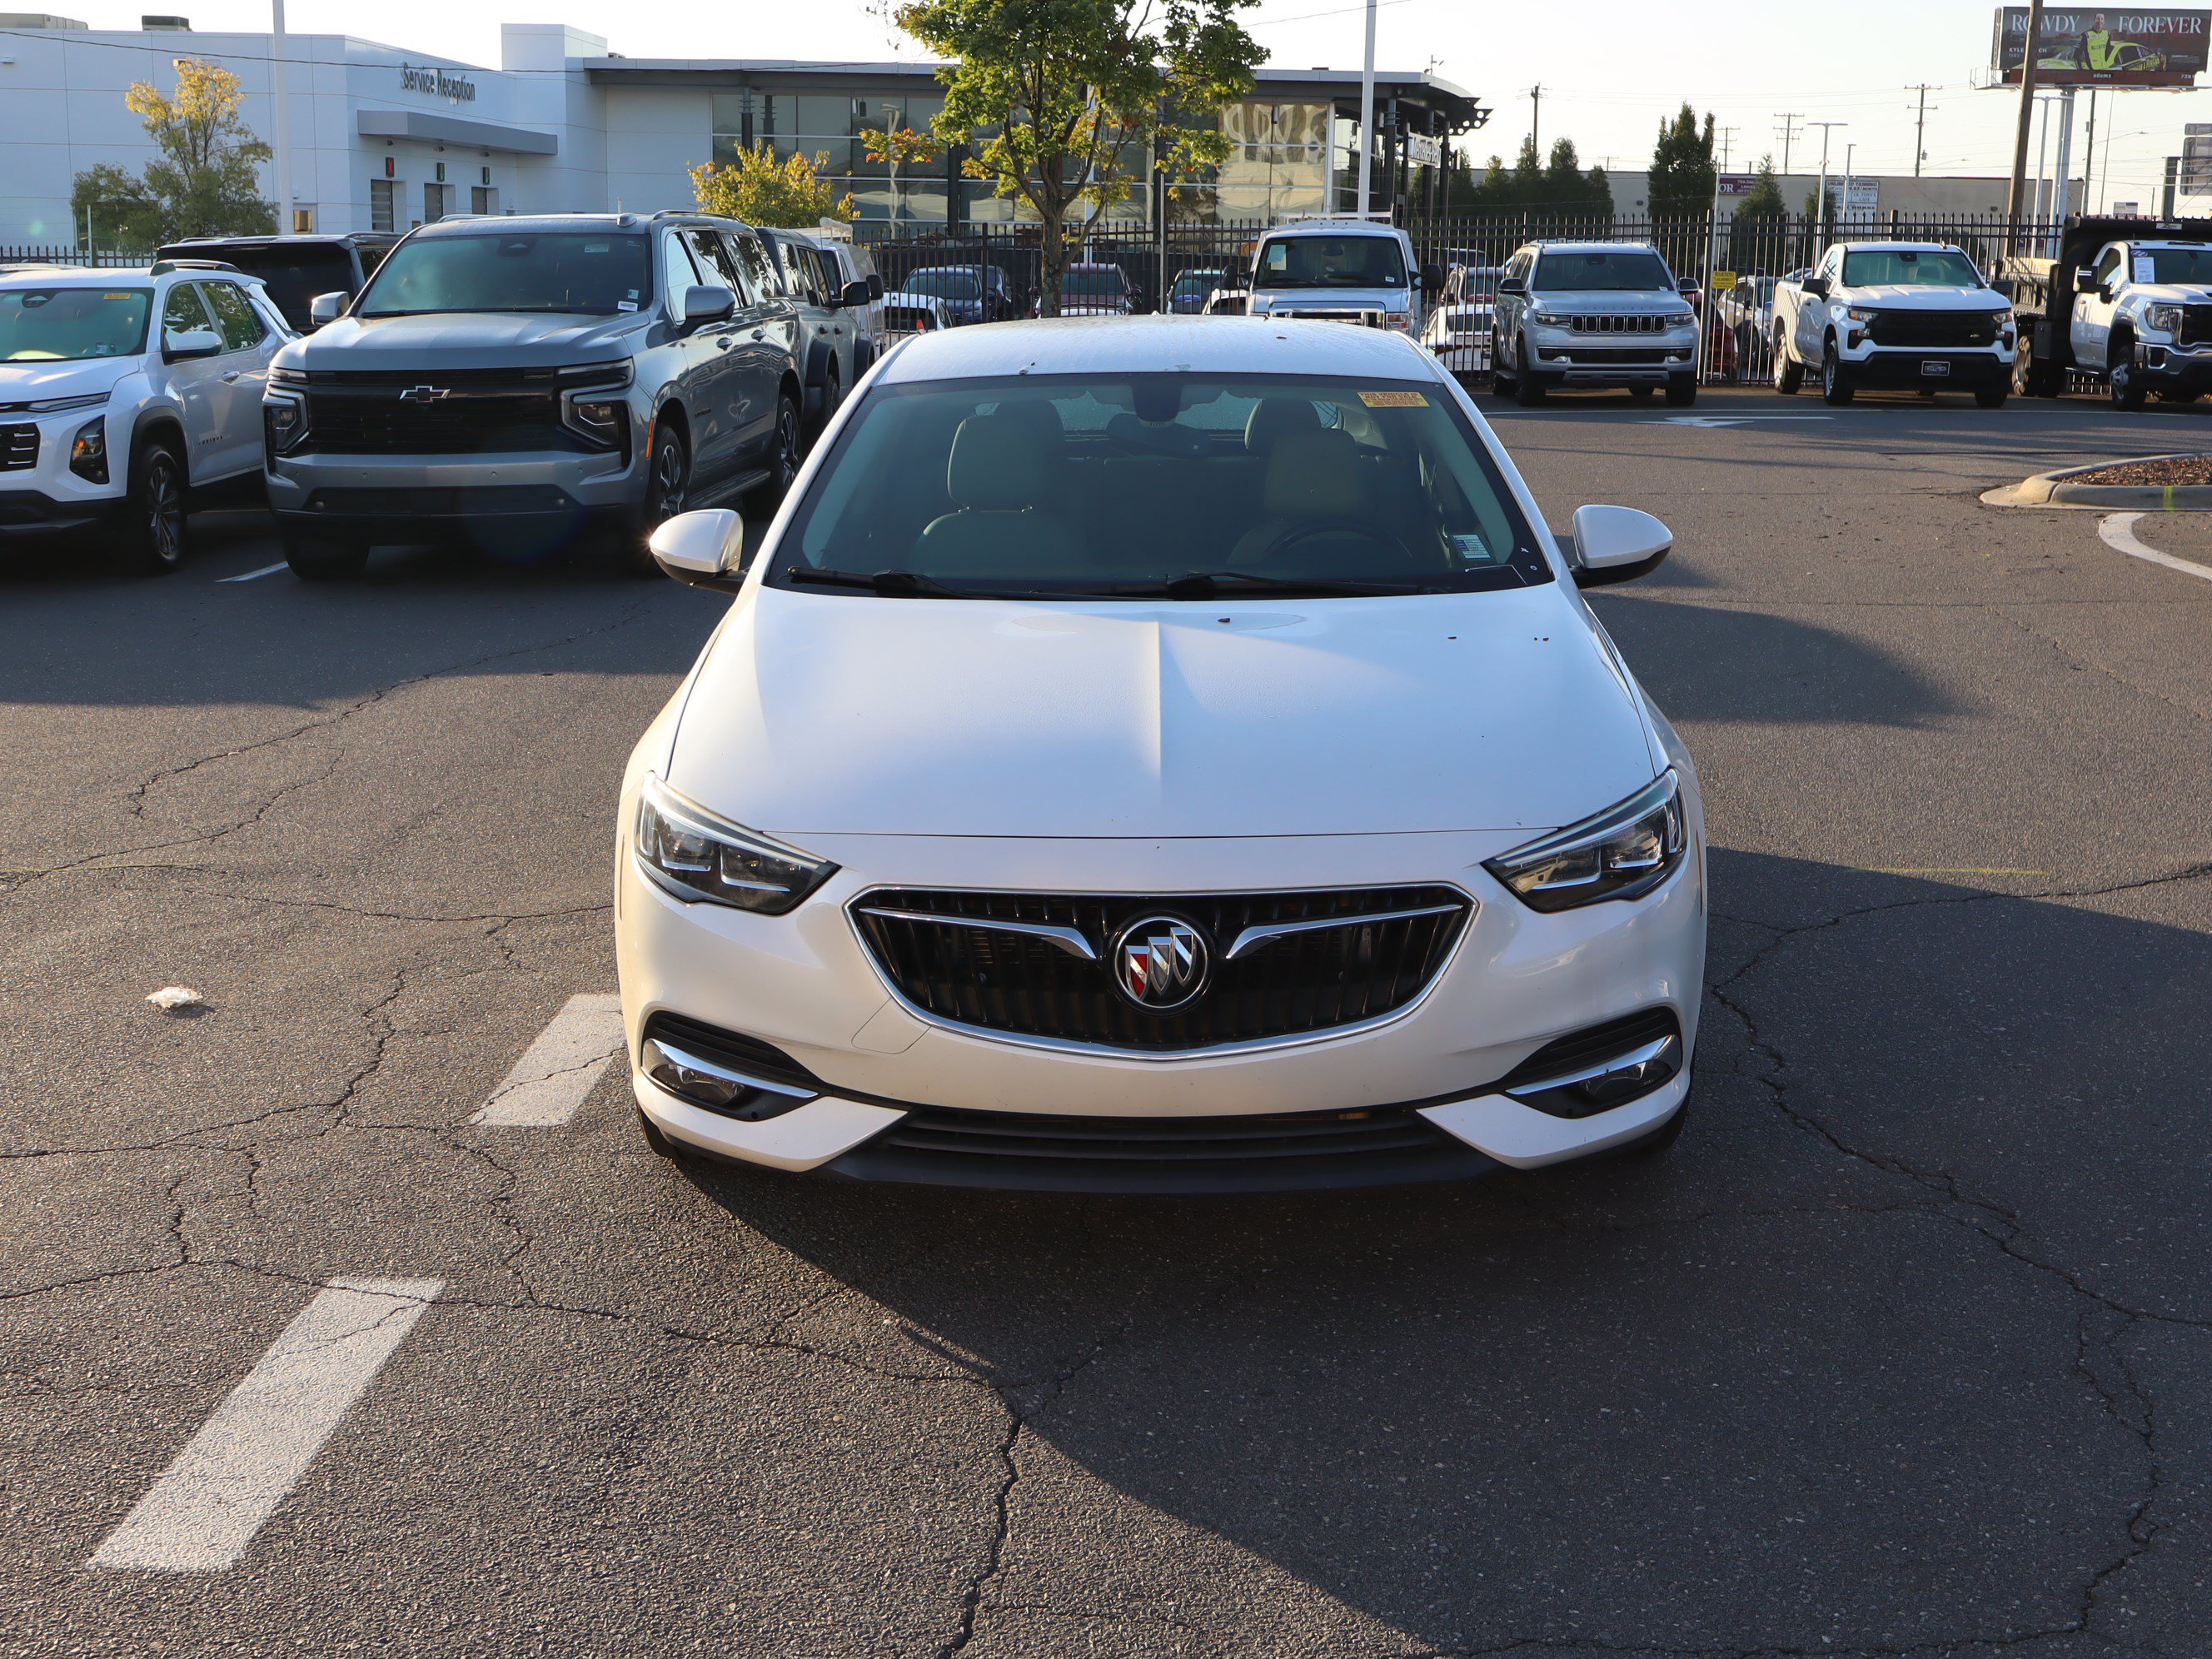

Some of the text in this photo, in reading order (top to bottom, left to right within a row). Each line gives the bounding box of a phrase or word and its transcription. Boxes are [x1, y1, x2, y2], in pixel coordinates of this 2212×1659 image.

[2118, 16, 2202, 34] FOREVER
[402, 62, 476, 105] Service Reception
